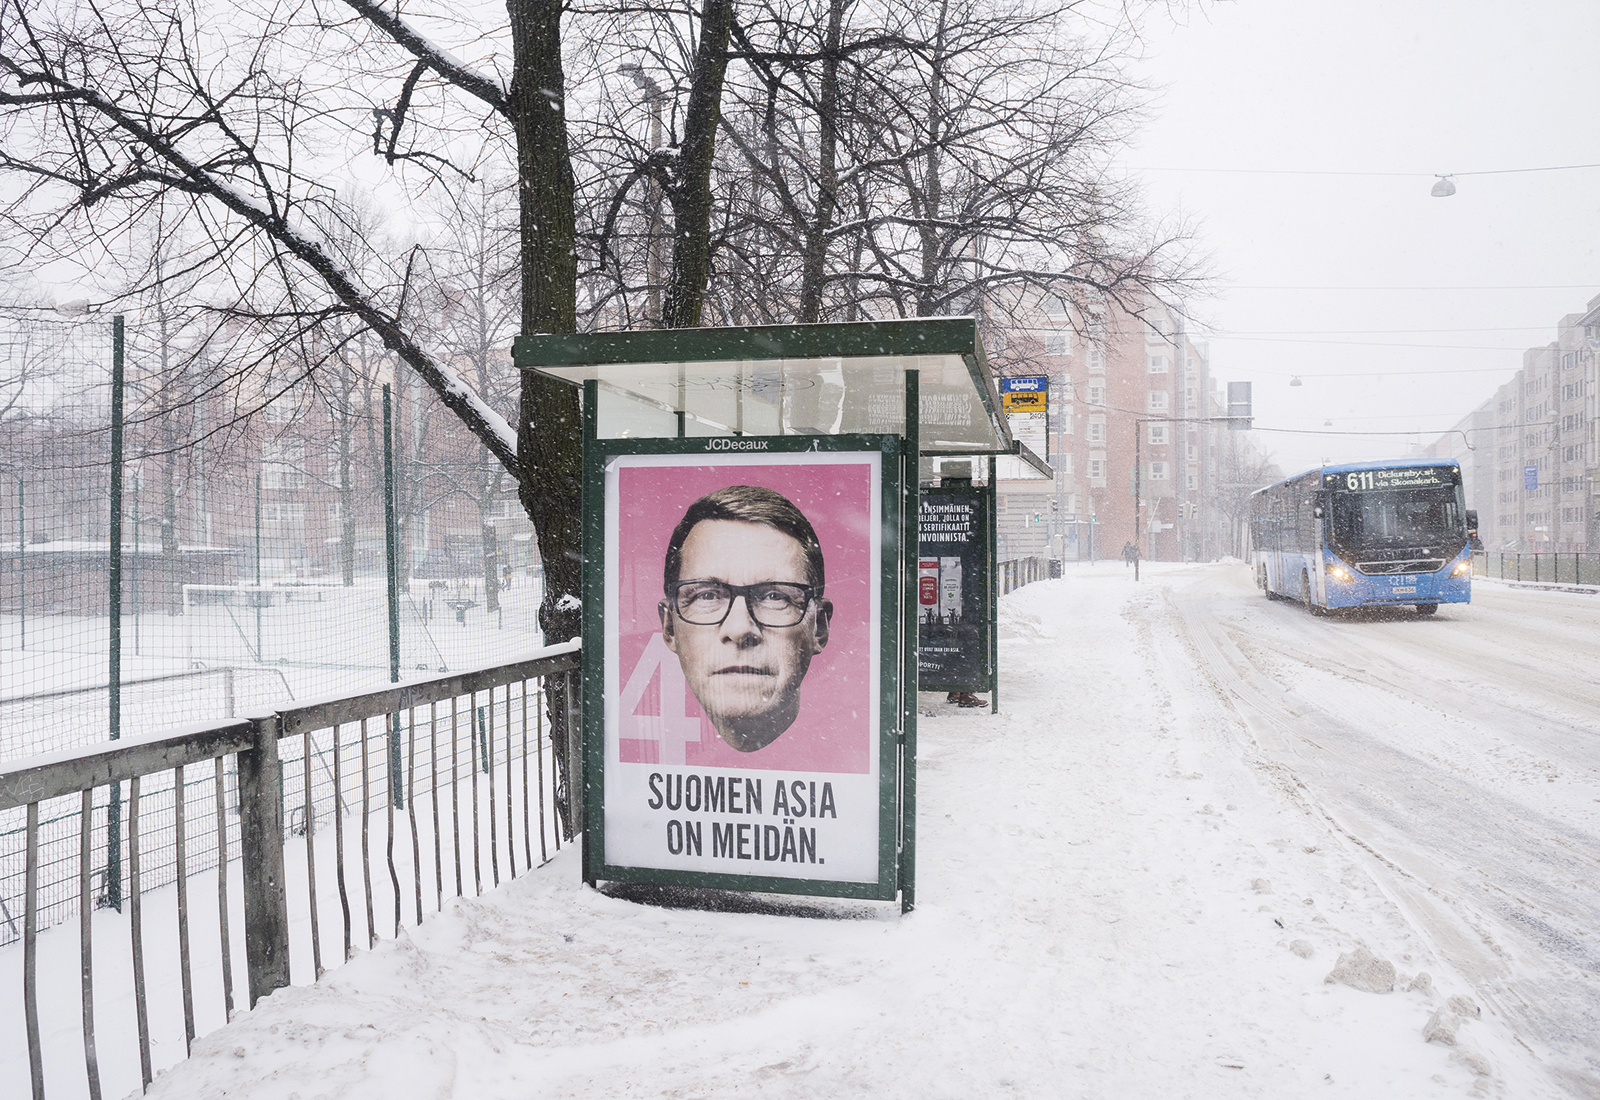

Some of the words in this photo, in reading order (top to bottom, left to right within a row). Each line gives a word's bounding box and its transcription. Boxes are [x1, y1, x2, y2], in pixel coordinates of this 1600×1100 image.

[705, 438, 769, 451] JCDecaux
[1347, 471, 1374, 491] 611
[1376, 479, 1389, 487] via
[924, 503, 970, 514] ENSIMMÄINEN
[943, 514, 960, 523] JOLLA
[961, 514, 970, 522] ON
[648, 772, 763, 815] SUOMEN
[772, 779, 838, 819] ASIA
[666, 819, 703, 857] ON
[712, 818, 825, 865] MEIDÄN.
